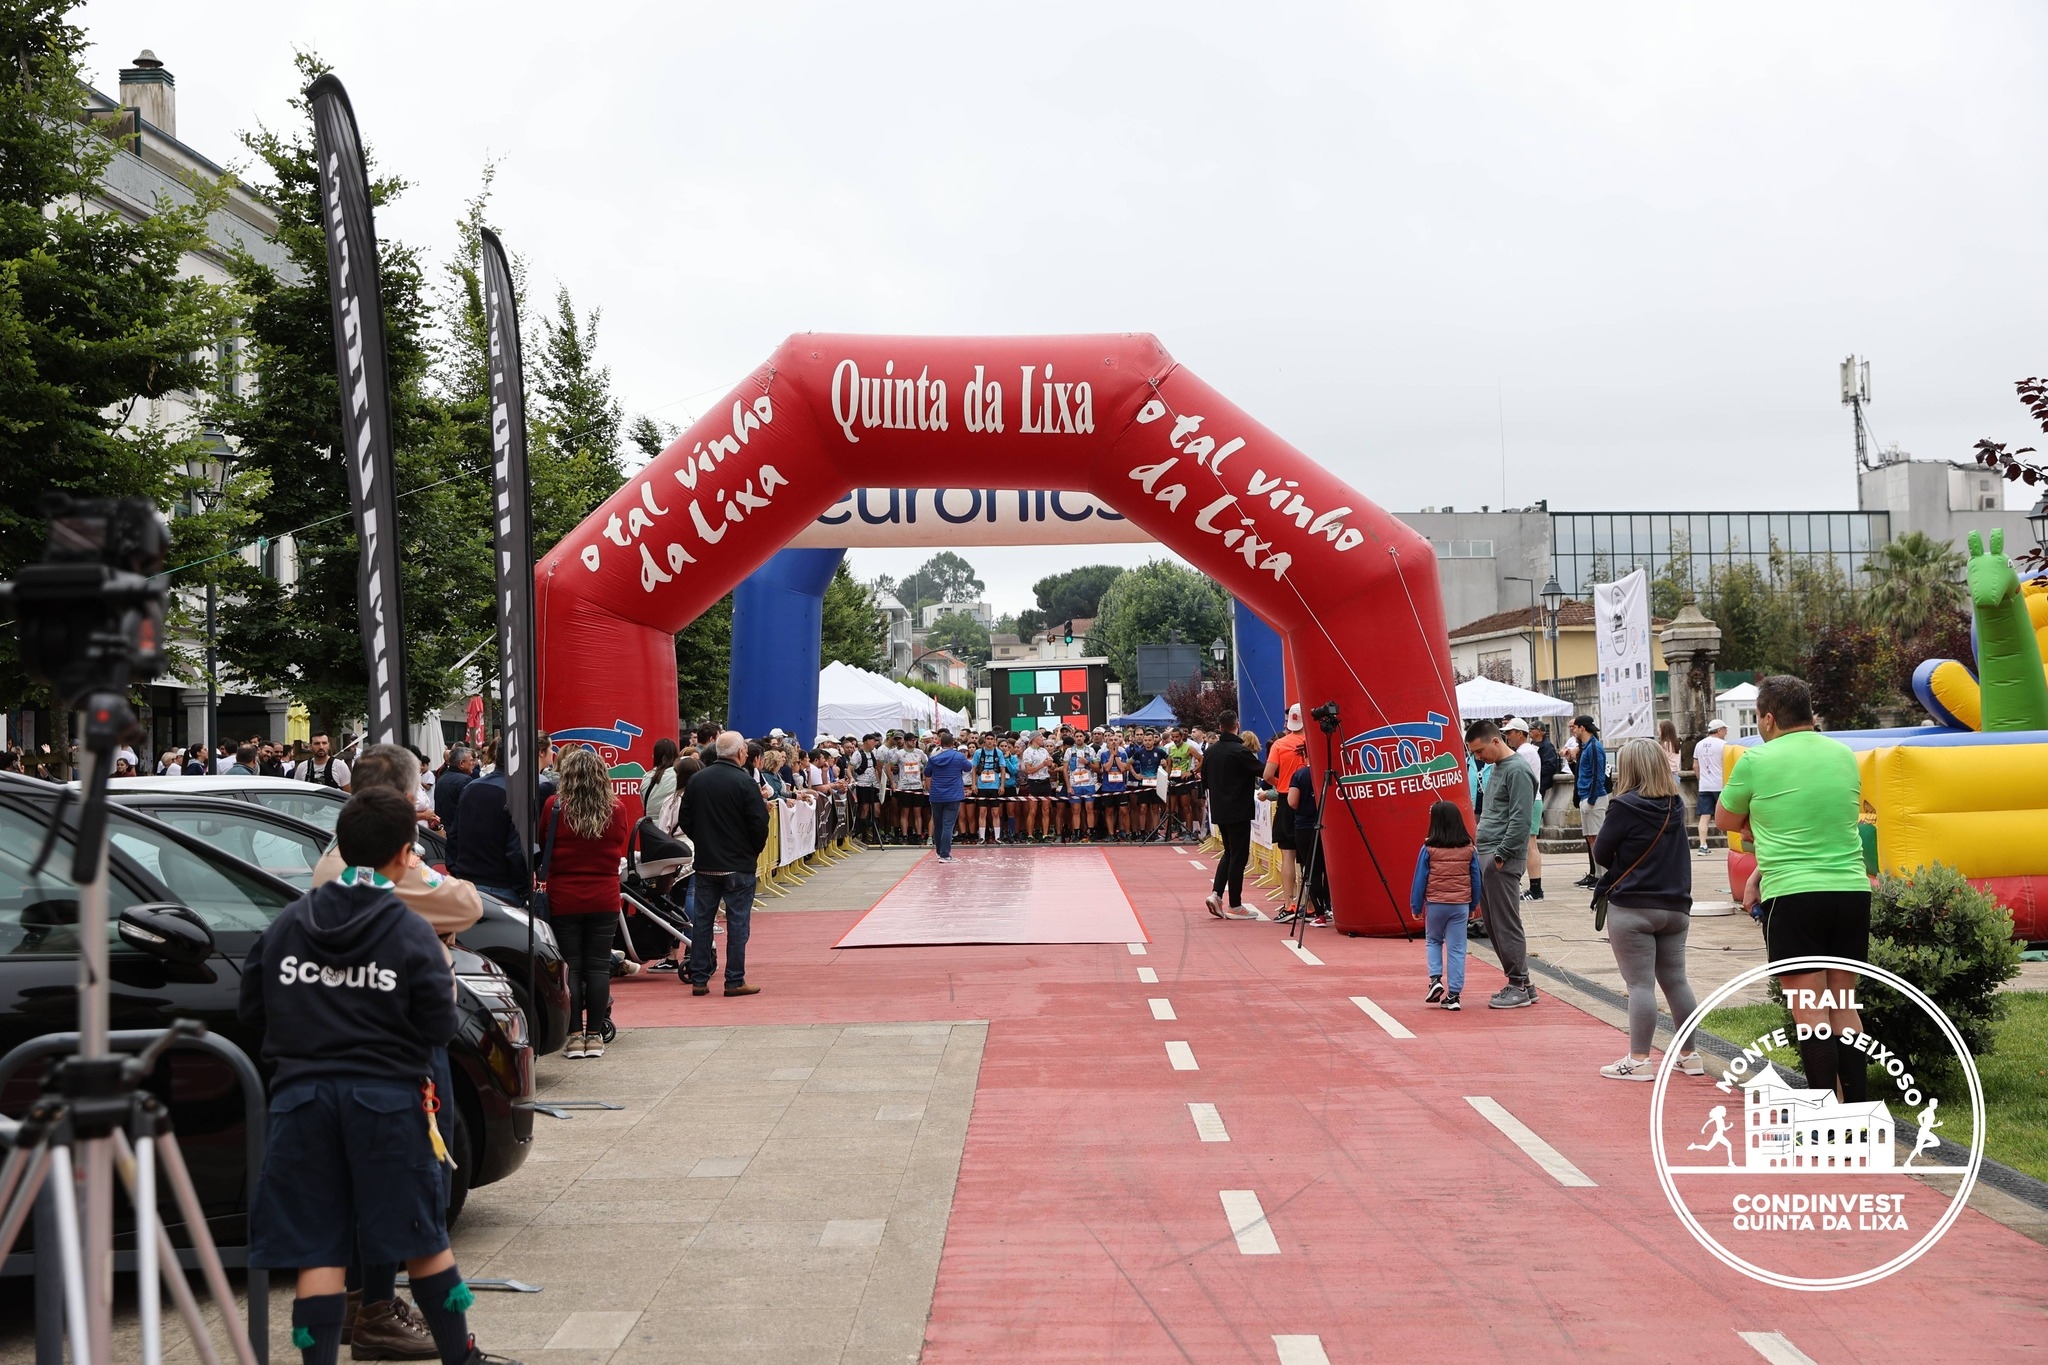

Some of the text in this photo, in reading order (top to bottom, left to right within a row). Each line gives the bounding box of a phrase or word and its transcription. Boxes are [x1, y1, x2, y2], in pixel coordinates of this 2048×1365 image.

[832, 359, 1096, 443] Quinta da Lixa
[580, 396, 773, 573] o tal vinho
[1137, 400, 1364, 552] o tal vinho
[639, 464, 789, 593] da Lixa
[1128, 457, 1293, 582] da Lixa
[1042, 695, 1055, 712] T
[1070, 694, 1082, 711] S
[1335, 783, 1374, 801] CLUBE
[1377, 781, 1397, 797] DE
[1400, 769, 1464, 795] FELGUEIRAS
[1339, 738, 1436, 777] MOTOR
[278, 954, 399, 993] Scouts
